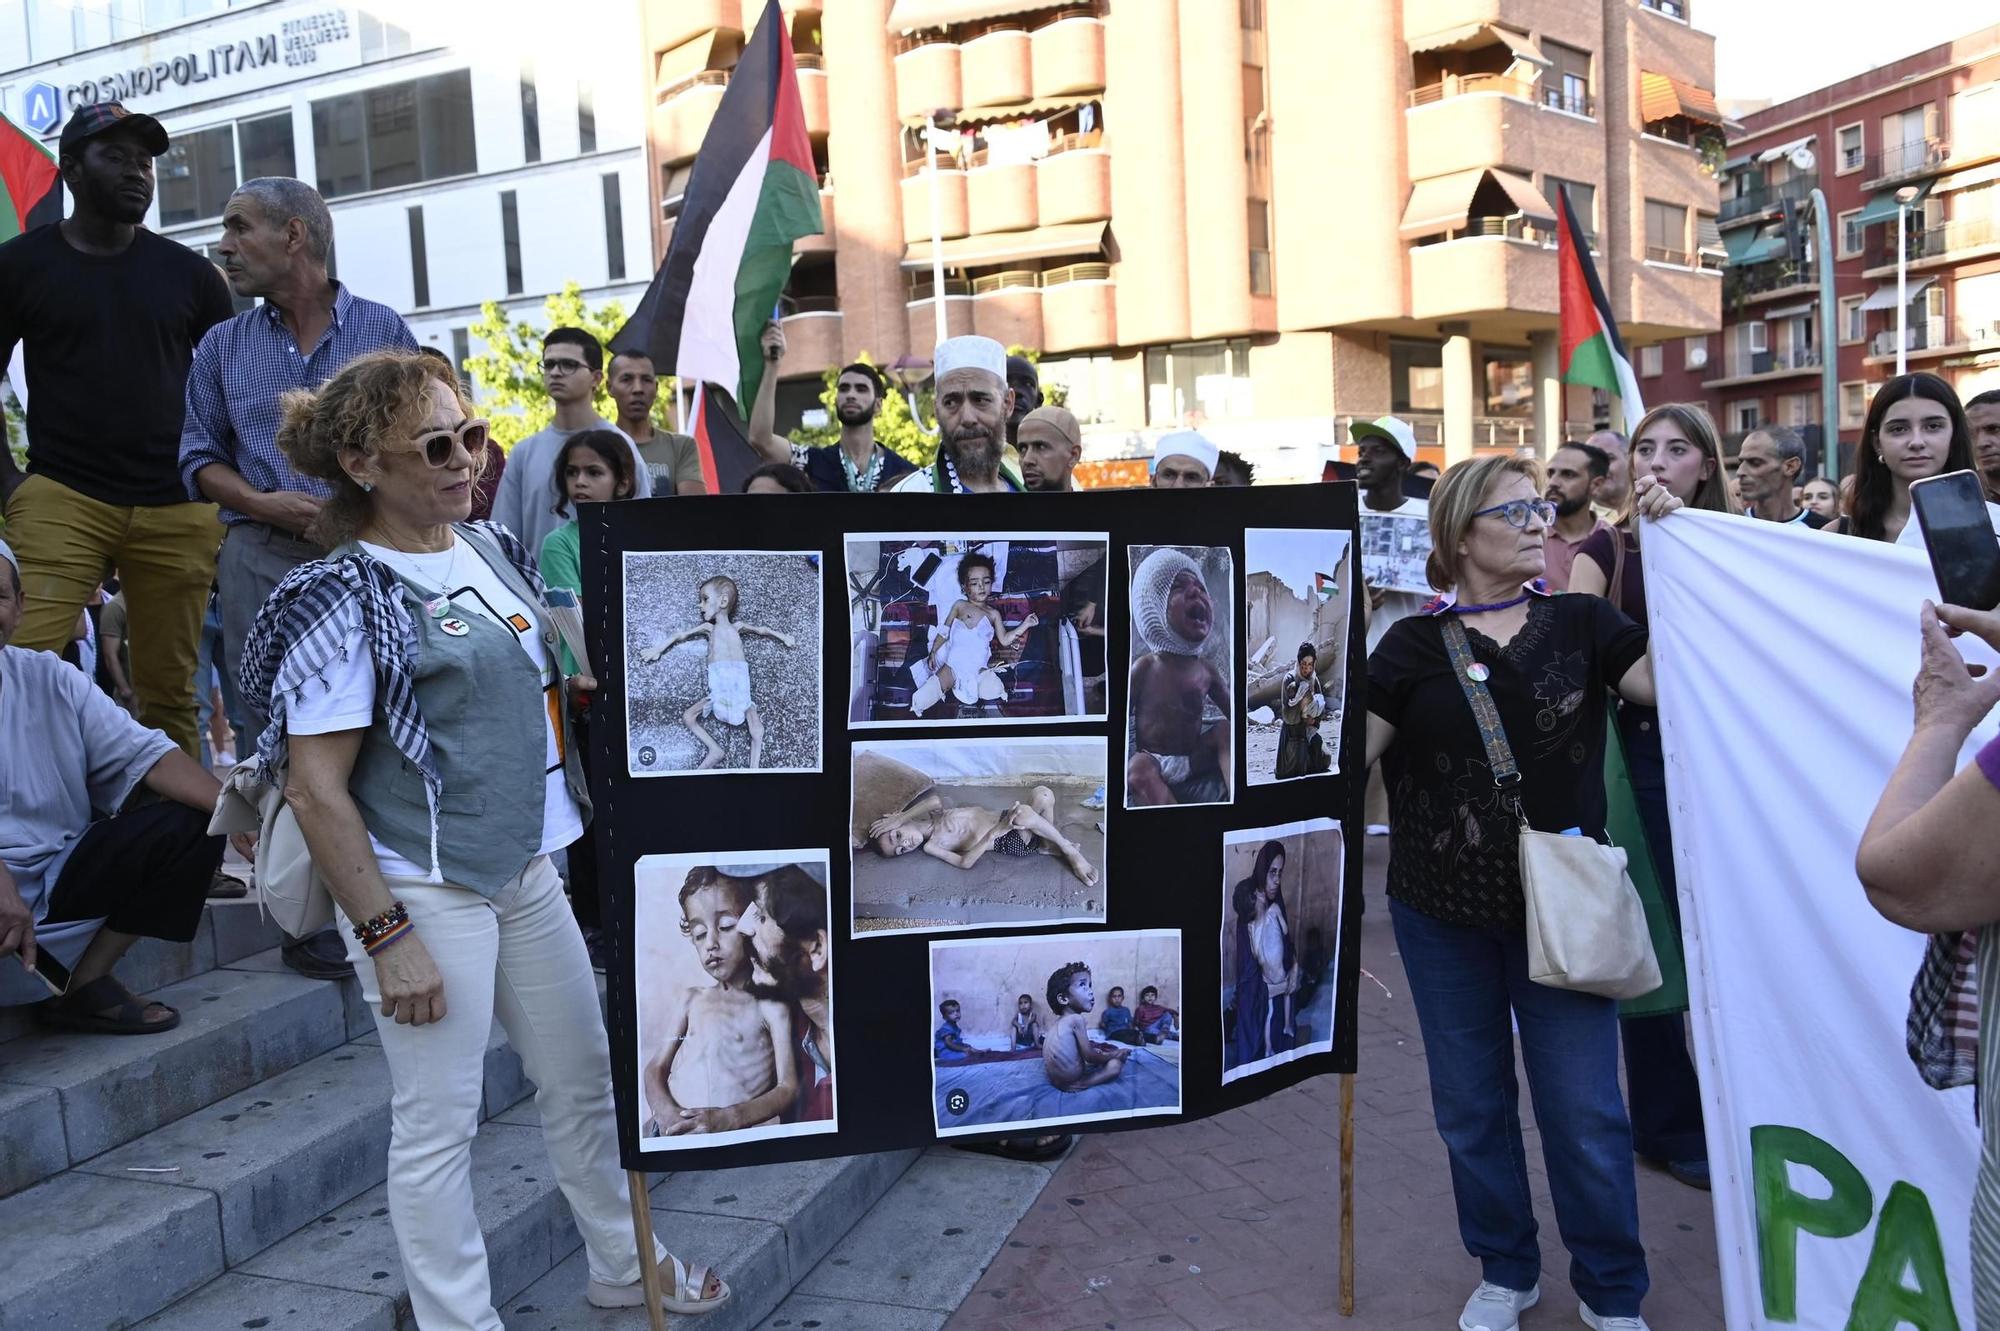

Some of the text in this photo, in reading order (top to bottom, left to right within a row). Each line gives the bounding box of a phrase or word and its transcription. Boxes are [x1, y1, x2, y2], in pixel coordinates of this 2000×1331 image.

[282, 14, 335, 36] FITNESS
[283, 26, 350, 52] WELLNESS
[284, 48, 317, 67] CLUB
[65, 34, 278, 110] COSMOPOLITAN
